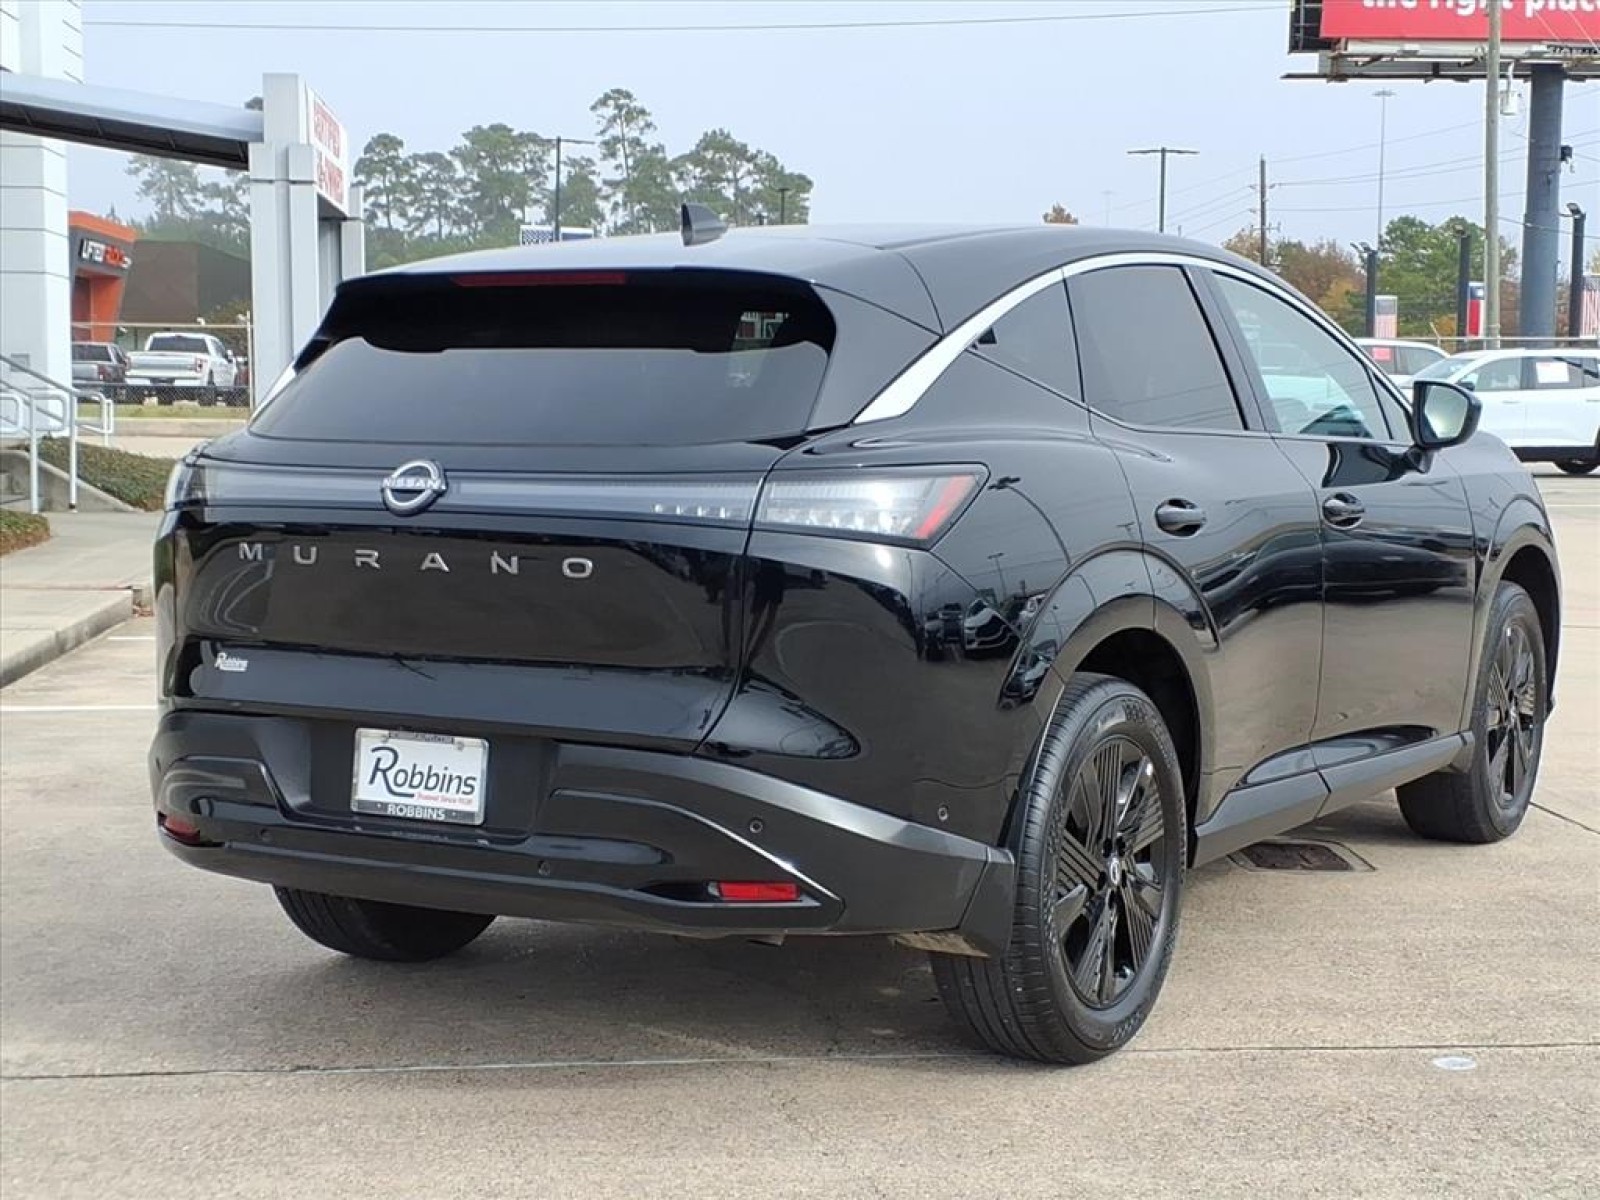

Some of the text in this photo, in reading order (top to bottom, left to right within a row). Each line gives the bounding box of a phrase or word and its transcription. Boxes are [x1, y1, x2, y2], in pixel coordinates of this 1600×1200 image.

[382, 477, 443, 491] NISSAN
[239, 542, 593, 579] MURANO
[368, 746, 478, 797] Robbins
[386, 804, 446, 820] ROBBINS
